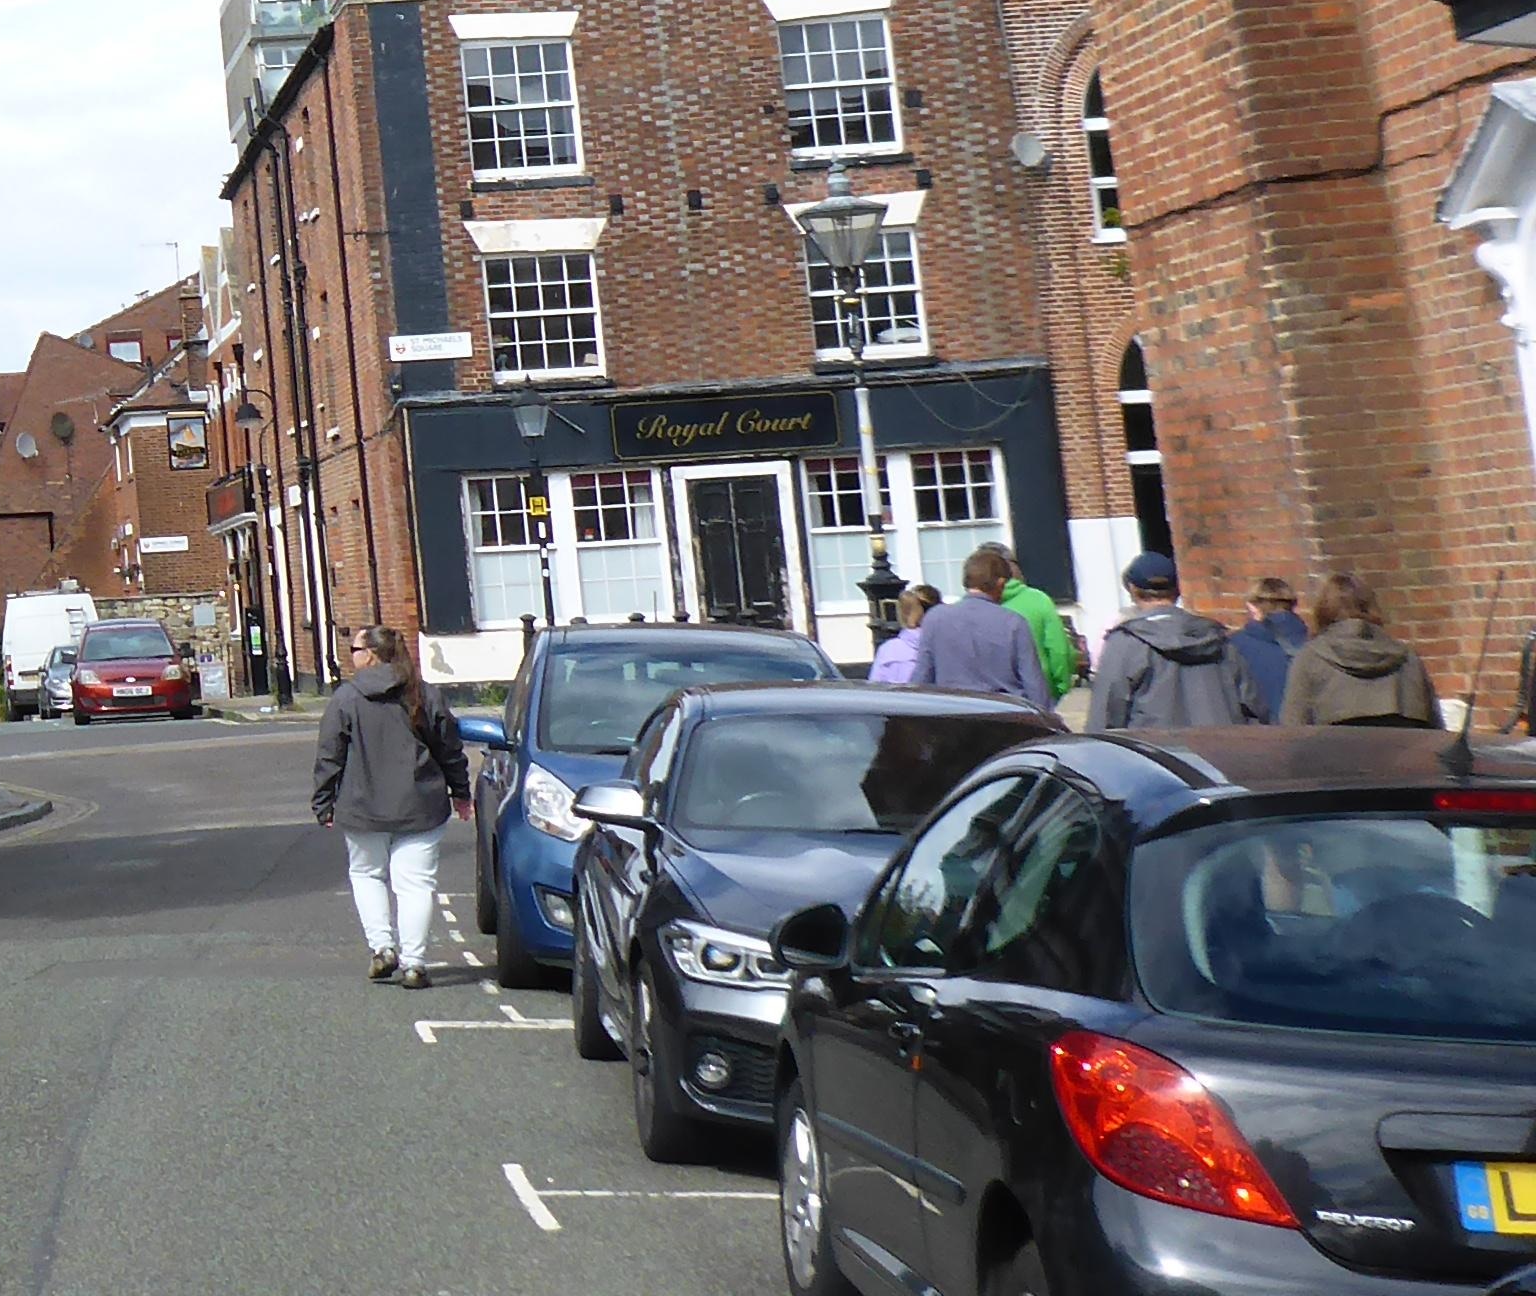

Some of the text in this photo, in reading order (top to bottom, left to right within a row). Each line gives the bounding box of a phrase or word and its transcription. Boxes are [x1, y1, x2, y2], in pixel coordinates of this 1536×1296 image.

[636, 408, 812, 447] Royal Court
[1316, 1210, 1416, 1231] PEUGEOT
